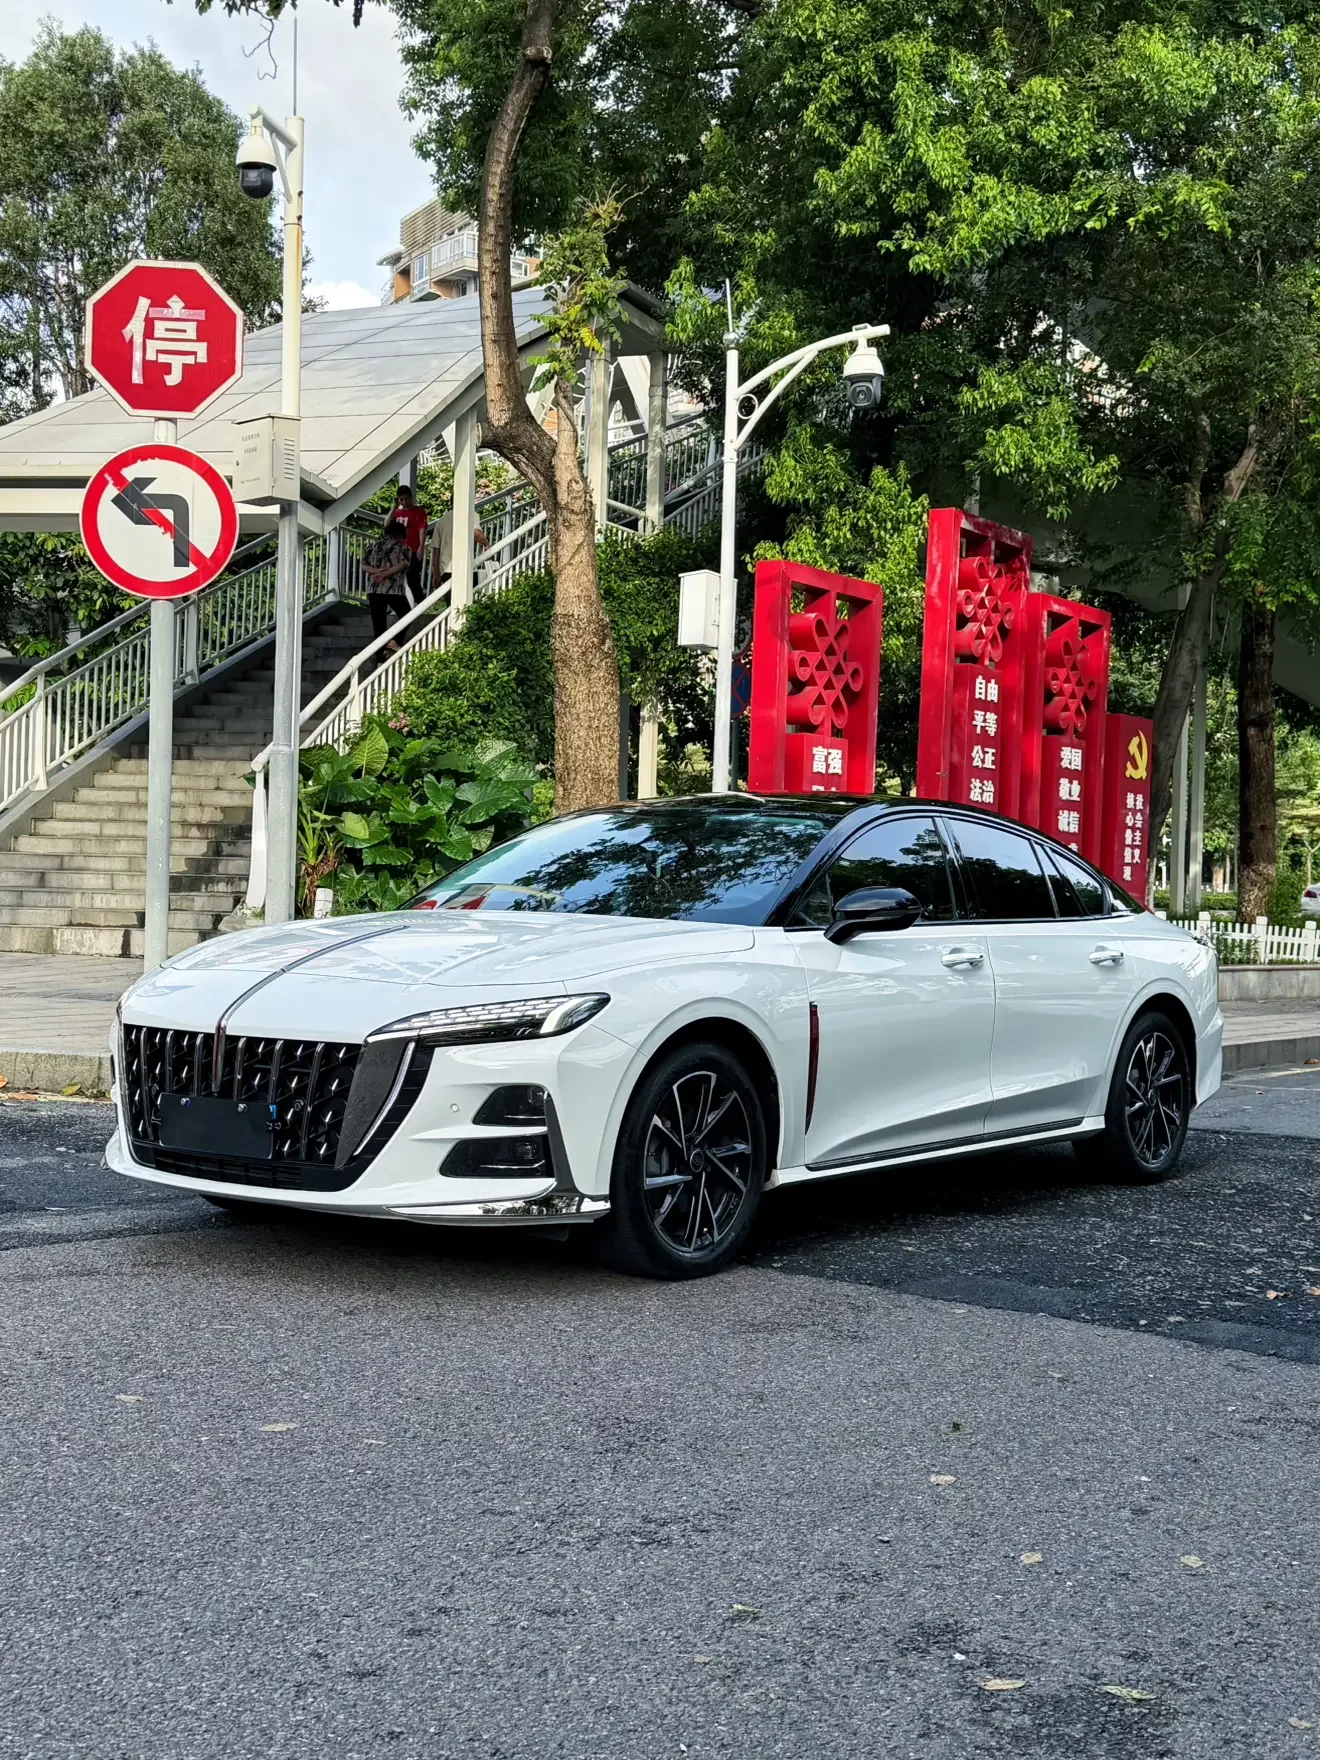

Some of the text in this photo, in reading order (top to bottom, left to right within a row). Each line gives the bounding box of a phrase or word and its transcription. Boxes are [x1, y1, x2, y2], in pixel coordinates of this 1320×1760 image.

[122, 294, 208, 386] 停
[975, 675, 999, 703] 自由
[972, 710, 998, 736] 平等
[812, 745, 843, 775] 富强
[971, 745, 996, 769] 公正
[1060, 747, 1083, 771] 爱国
[969, 777, 995, 803] 法治
[1059, 778, 1081, 801] 敬业
[1057, 809, 1080, 834] 诚信
[1132, 794, 1144, 864] 社会主义
[1122, 792, 1135, 881] 核心价值观
